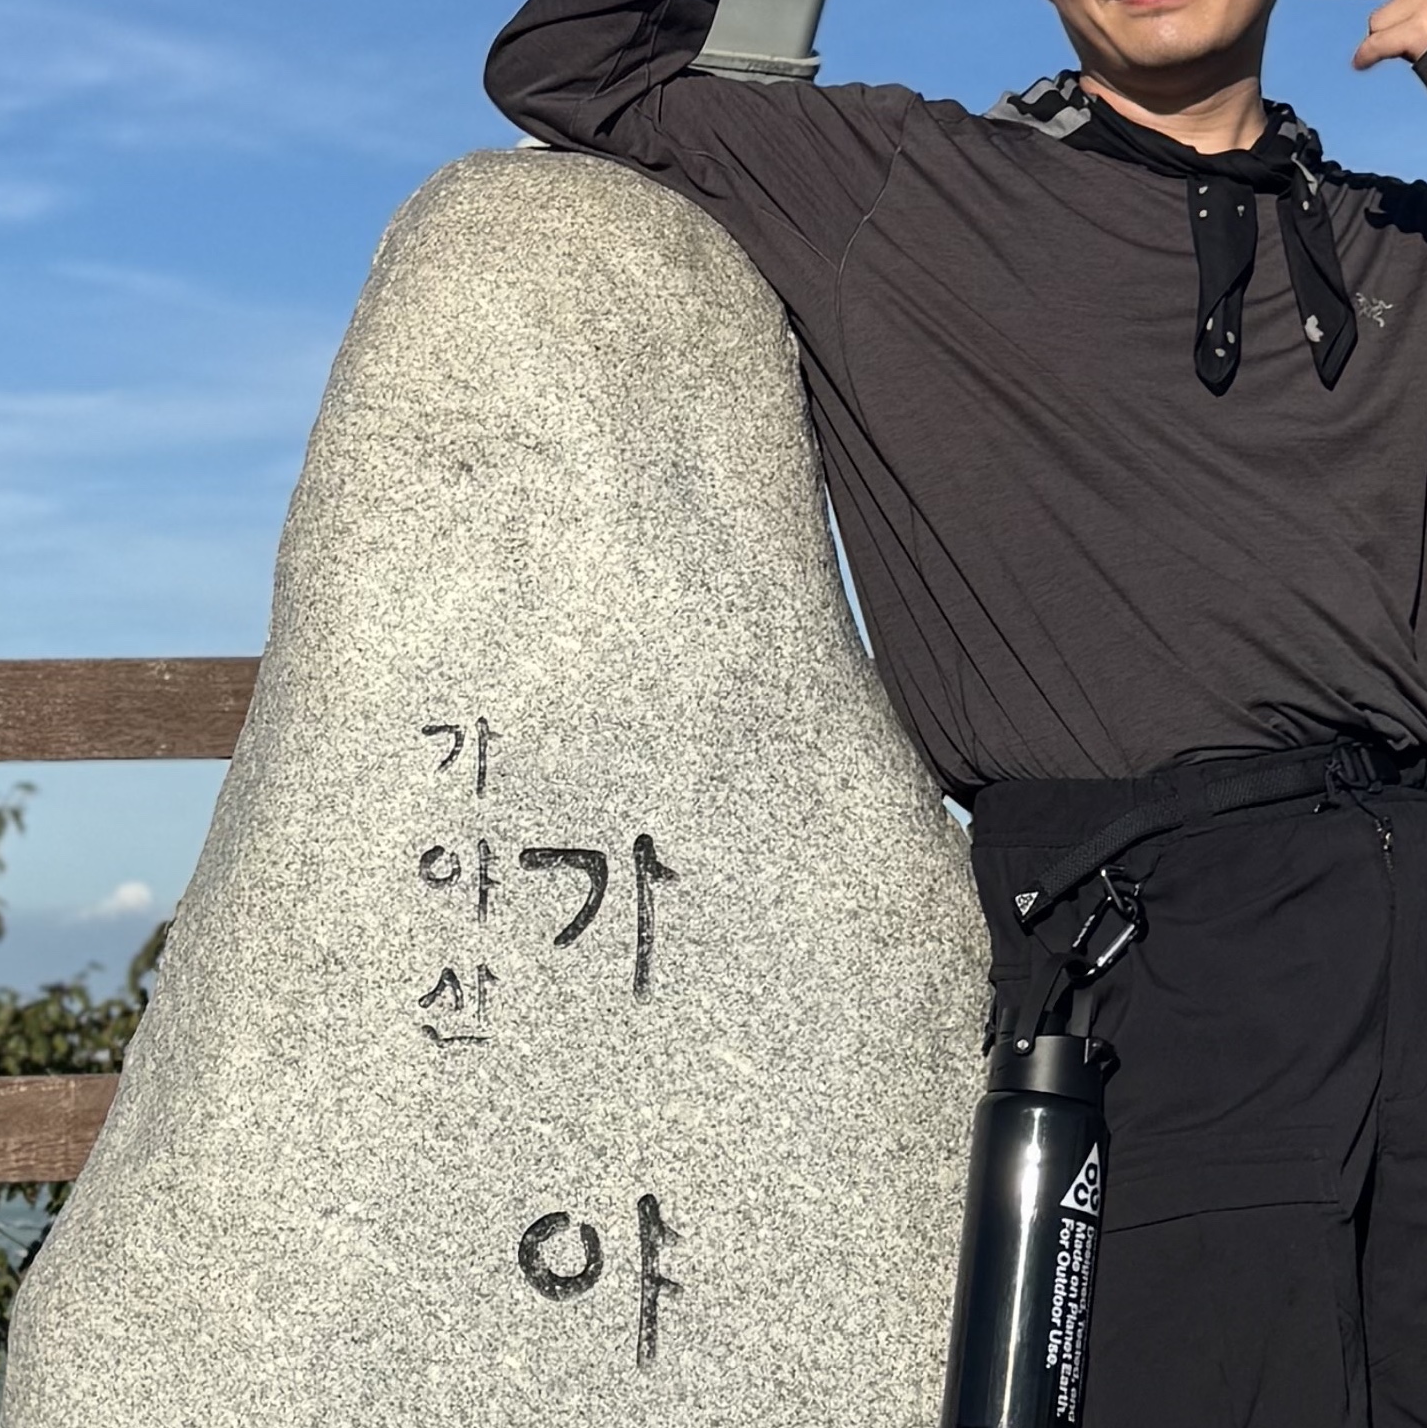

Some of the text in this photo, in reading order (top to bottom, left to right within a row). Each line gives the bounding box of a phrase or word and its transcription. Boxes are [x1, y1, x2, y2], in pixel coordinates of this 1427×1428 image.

[418, 715, 502, 1048] 가야산
[1045, 1217, 1075, 1369] For Outdoor Use.
[1056, 1220, 1087, 1417] Made on Planet Earth.
